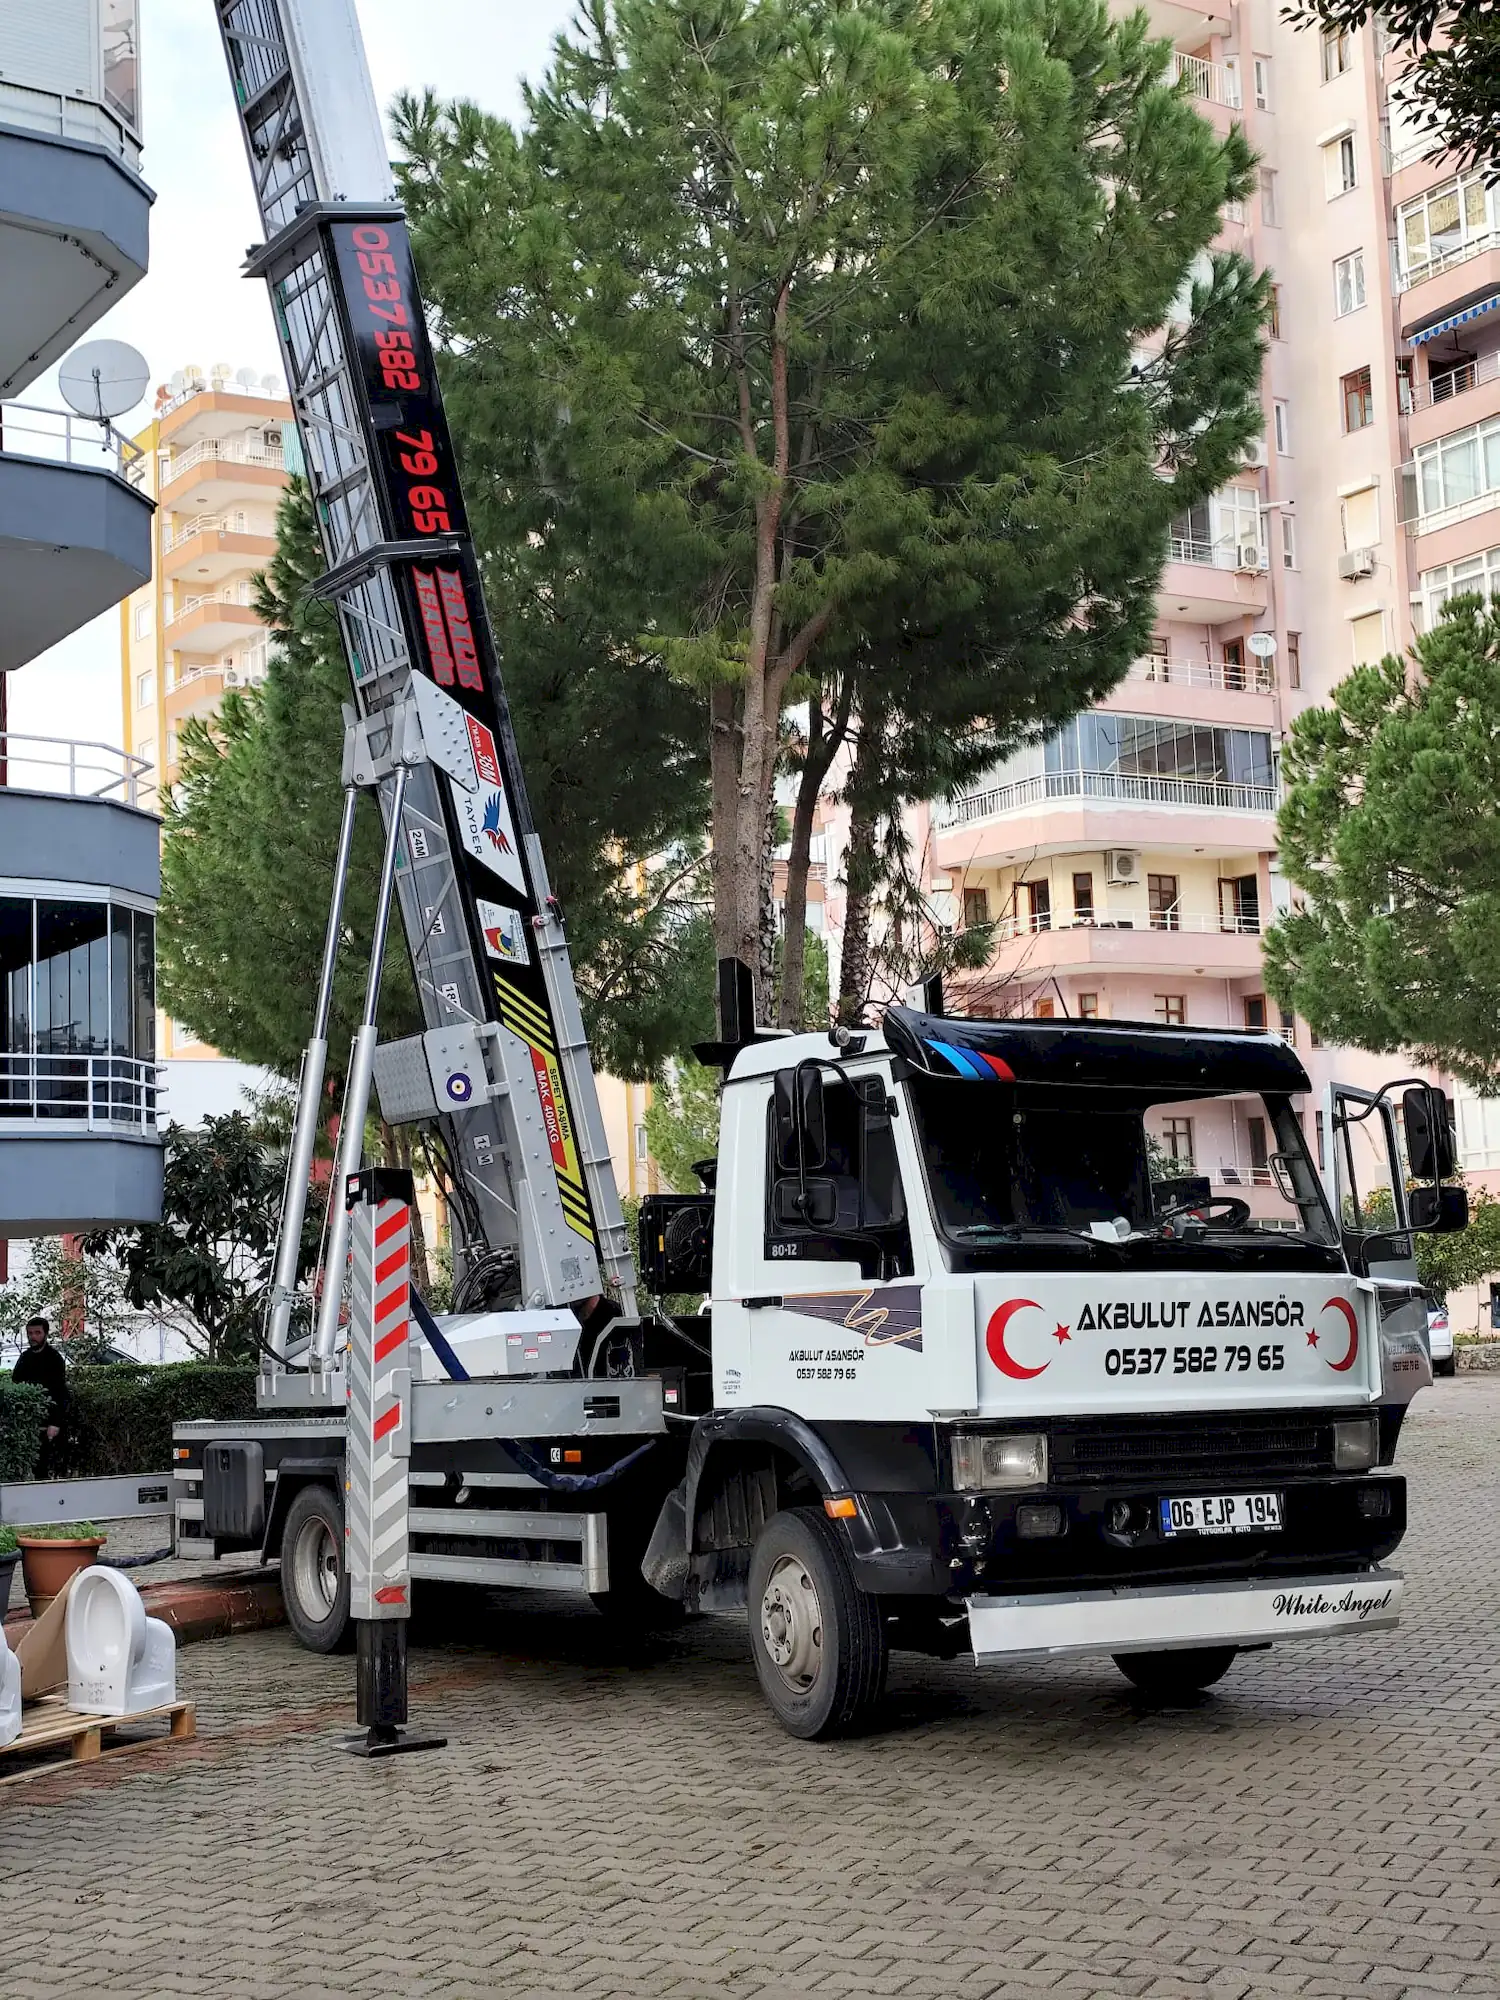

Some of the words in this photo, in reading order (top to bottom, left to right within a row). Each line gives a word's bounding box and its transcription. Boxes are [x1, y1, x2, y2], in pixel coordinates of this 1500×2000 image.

[352, 225, 408, 327] 0537
[374, 330, 421, 390] 582
[396, 429, 438, 476] 79
[408, 485, 451, 533] 65
[477, 750, 498, 784] 38M
[412, 831, 426, 858] 24M
[464, 797, 483, 855] TAYDER
[537, 1070, 551, 1102] MAK.
[544, 1104, 560, 1144] 400KG
[550, 1068, 561, 1099] SEPET
[557, 1104, 570, 1141] TAŞIMA
[1076, 1301, 1191, 1331] AKBULUT
[1196, 1294, 1304, 1328] ASANSÖR
[788, 1349, 824, 1362] AKBULUT
[825, 1346, 865, 1361] ASANSÖR
[1105, 1347, 1167, 1376] 0537
[1173, 1346, 1217, 1374] 582
[1223, 1345, 1251, 1372] 79
[1257, 1344, 1285, 1371] 65
[796, 1368, 816, 1380] 0537
[817, 1368, 832, 1380] 582
[834, 1368, 844, 1379] 79
[845, 1368, 857, 1379] 65
[1171, 1500, 1194, 1528] 06
[1202, 1498, 1235, 1525] EJP
[1245, 1496, 1277, 1523] 194
[1272, 1593, 1333, 1617] White
[1332, 1589, 1392, 1620] Angel
